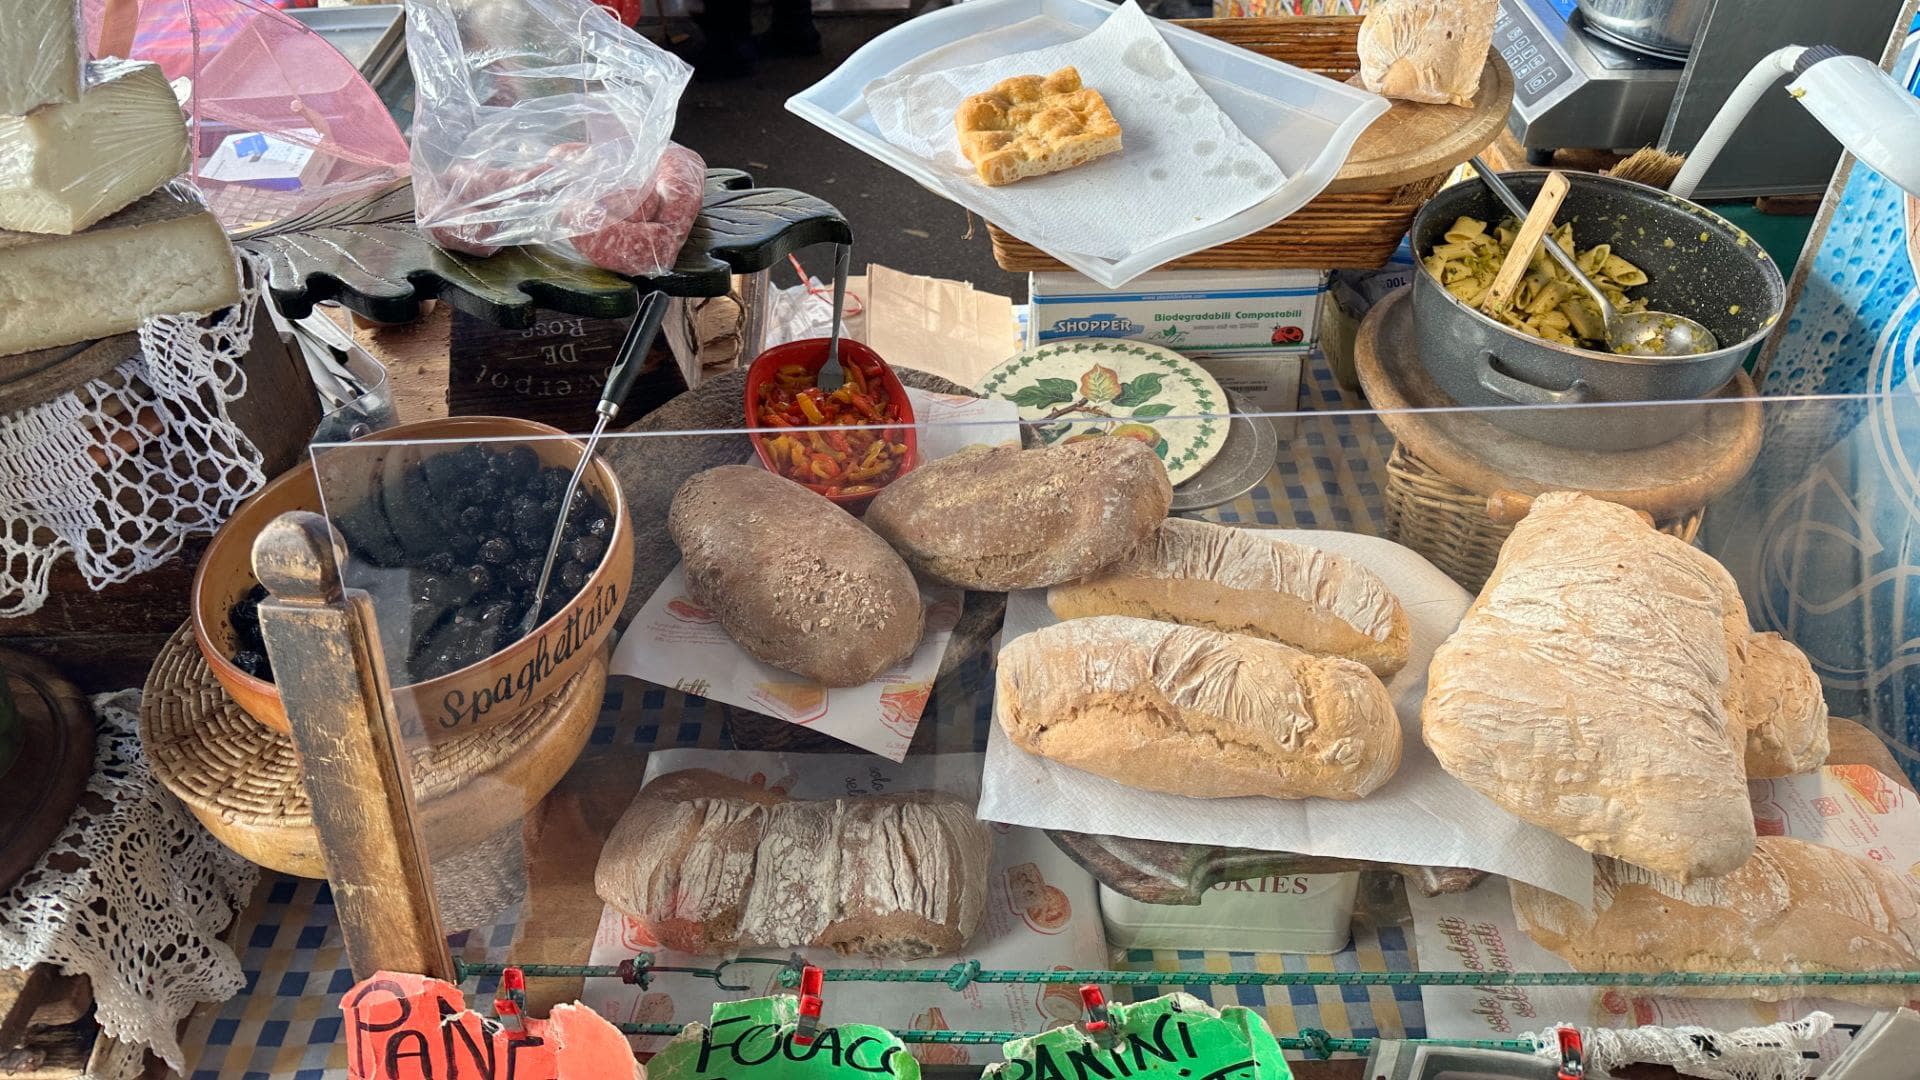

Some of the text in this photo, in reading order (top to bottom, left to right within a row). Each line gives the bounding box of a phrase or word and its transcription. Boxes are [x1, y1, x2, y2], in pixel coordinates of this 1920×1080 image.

[1056, 318, 1133, 334] SHOPPER
[1154, 308, 1302, 324] Biodegradabili Compostabili
[539, 343, 578, 366] DE
[439, 582, 618, 729] Spaghettata
[1212, 875, 1309, 895] OKIES
[1437, 915, 1504, 993] odotti
[1470, 919, 1536, 1019] seleionati
